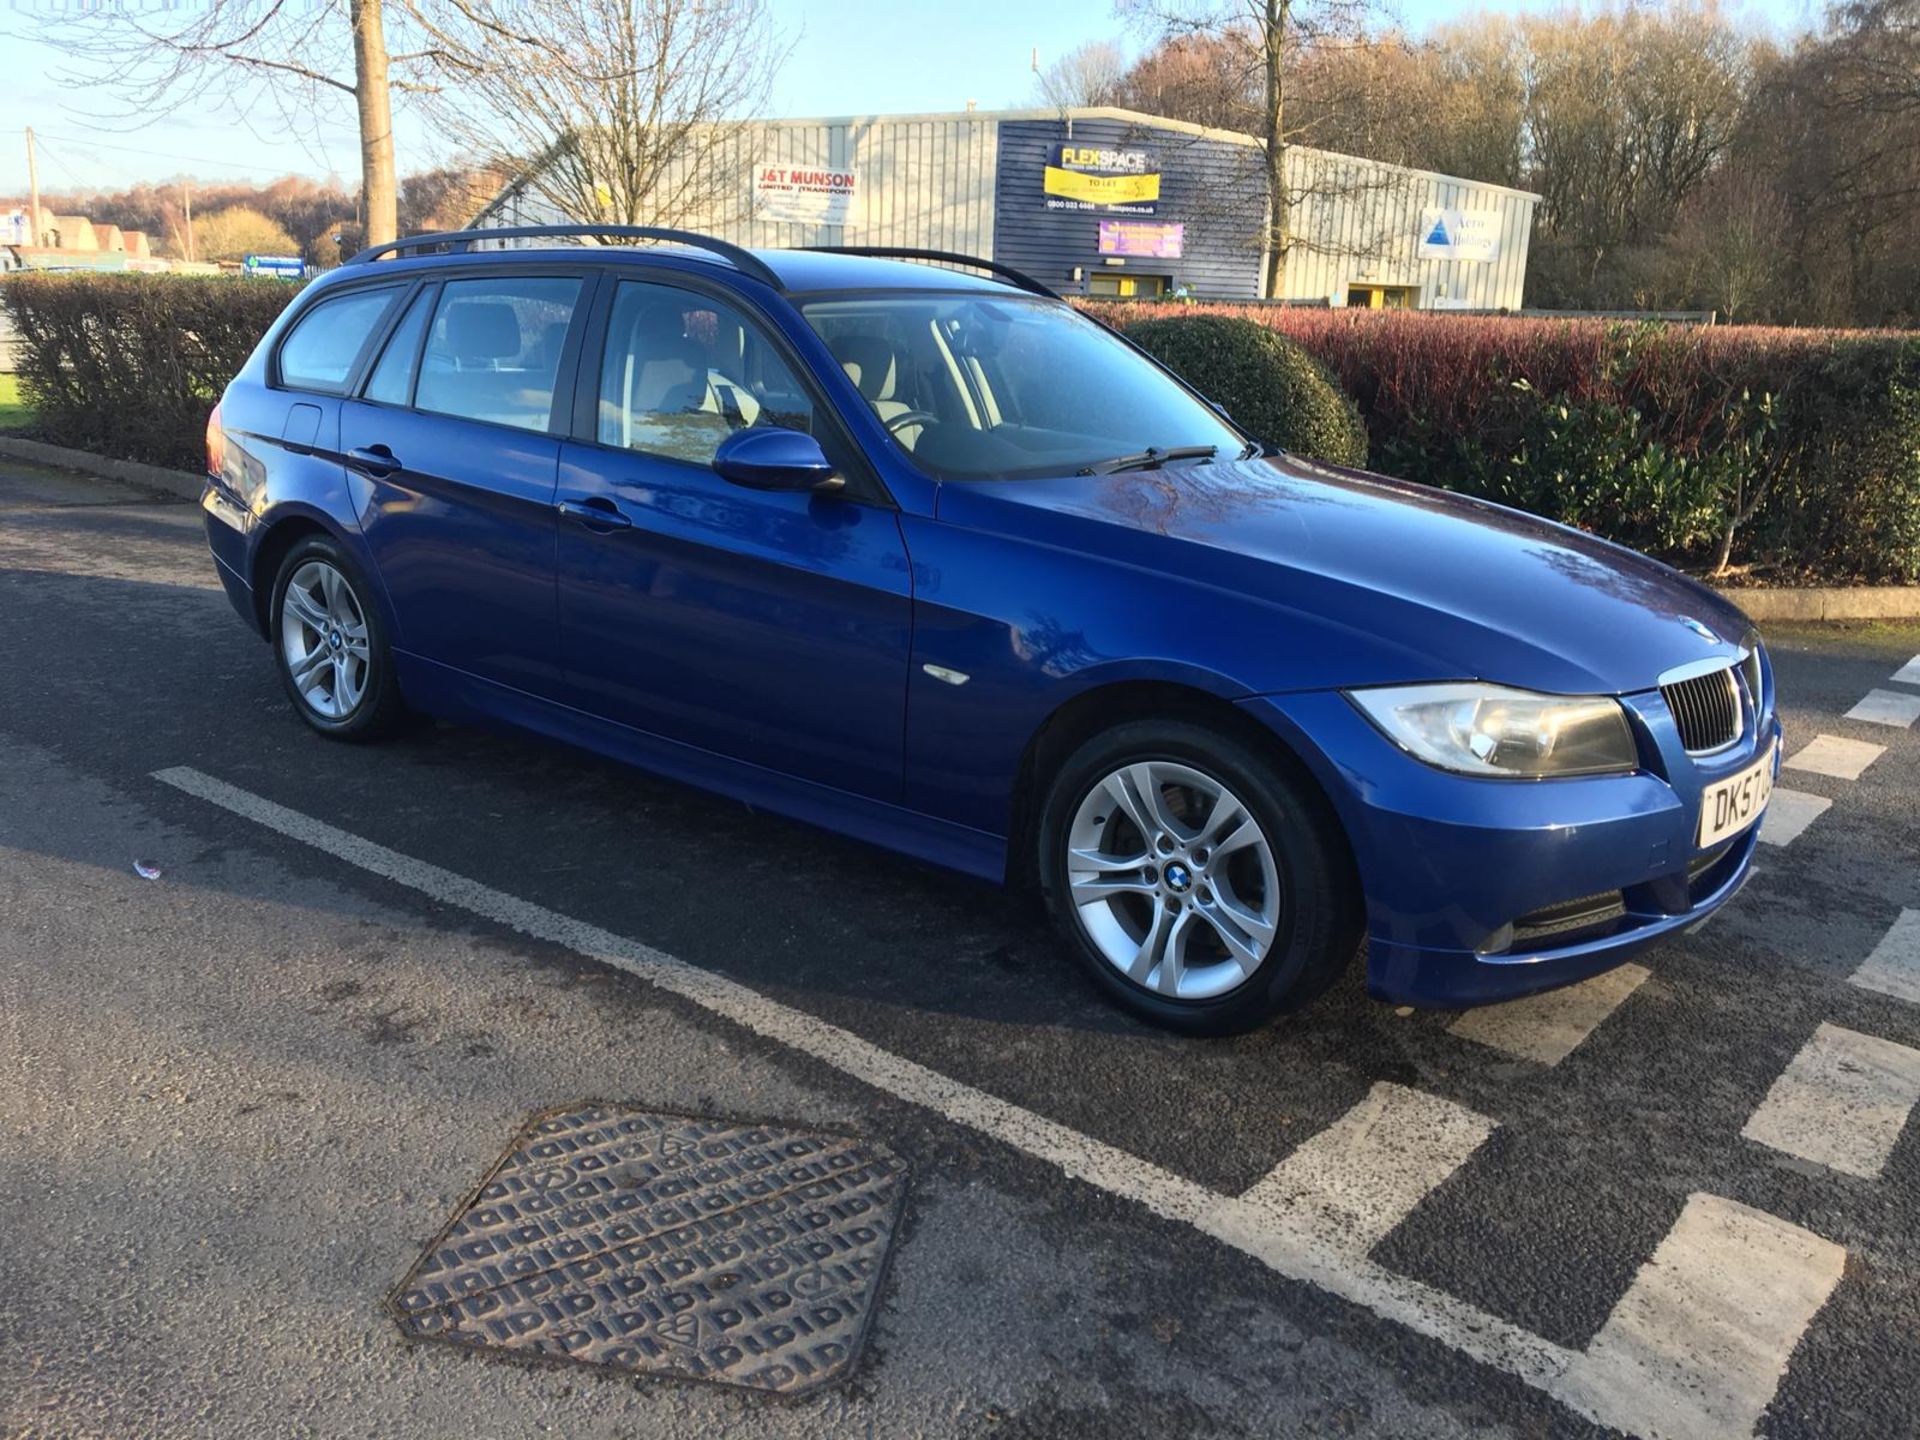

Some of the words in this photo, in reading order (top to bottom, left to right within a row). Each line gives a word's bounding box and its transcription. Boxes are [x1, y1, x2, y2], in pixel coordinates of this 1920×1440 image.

[1062, 149, 1145, 168] FLEXSPACE
[760, 168, 786, 183] J&T
[790, 171, 855, 187] MUNSON
[1089, 179, 1100, 187] TO
[1714, 768, 1762, 832] DK57
